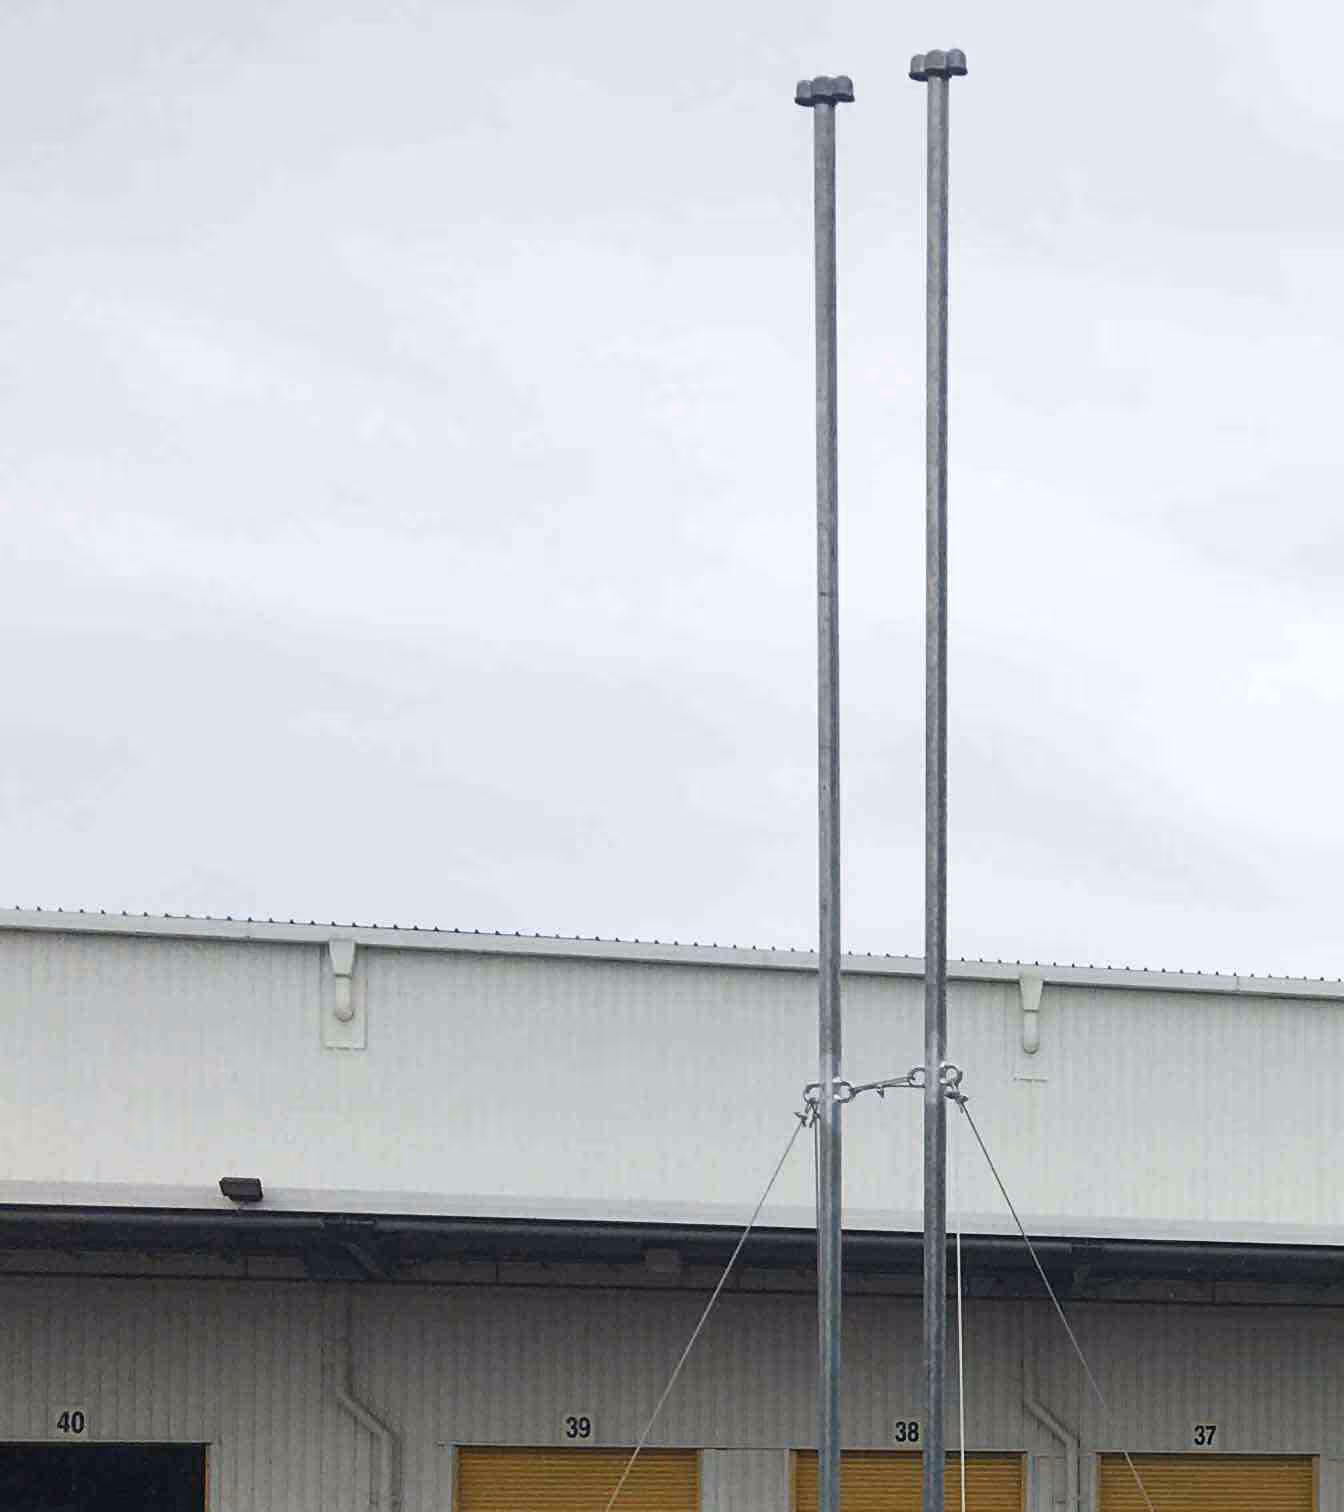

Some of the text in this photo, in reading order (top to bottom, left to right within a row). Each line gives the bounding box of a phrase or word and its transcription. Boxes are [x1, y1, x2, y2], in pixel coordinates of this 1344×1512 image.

[57, 1411, 84, 1433] 40
[566, 1417, 590, 1437] 39
[896, 1422, 919, 1441] 38
[1195, 1425, 1217, 1445] 37
